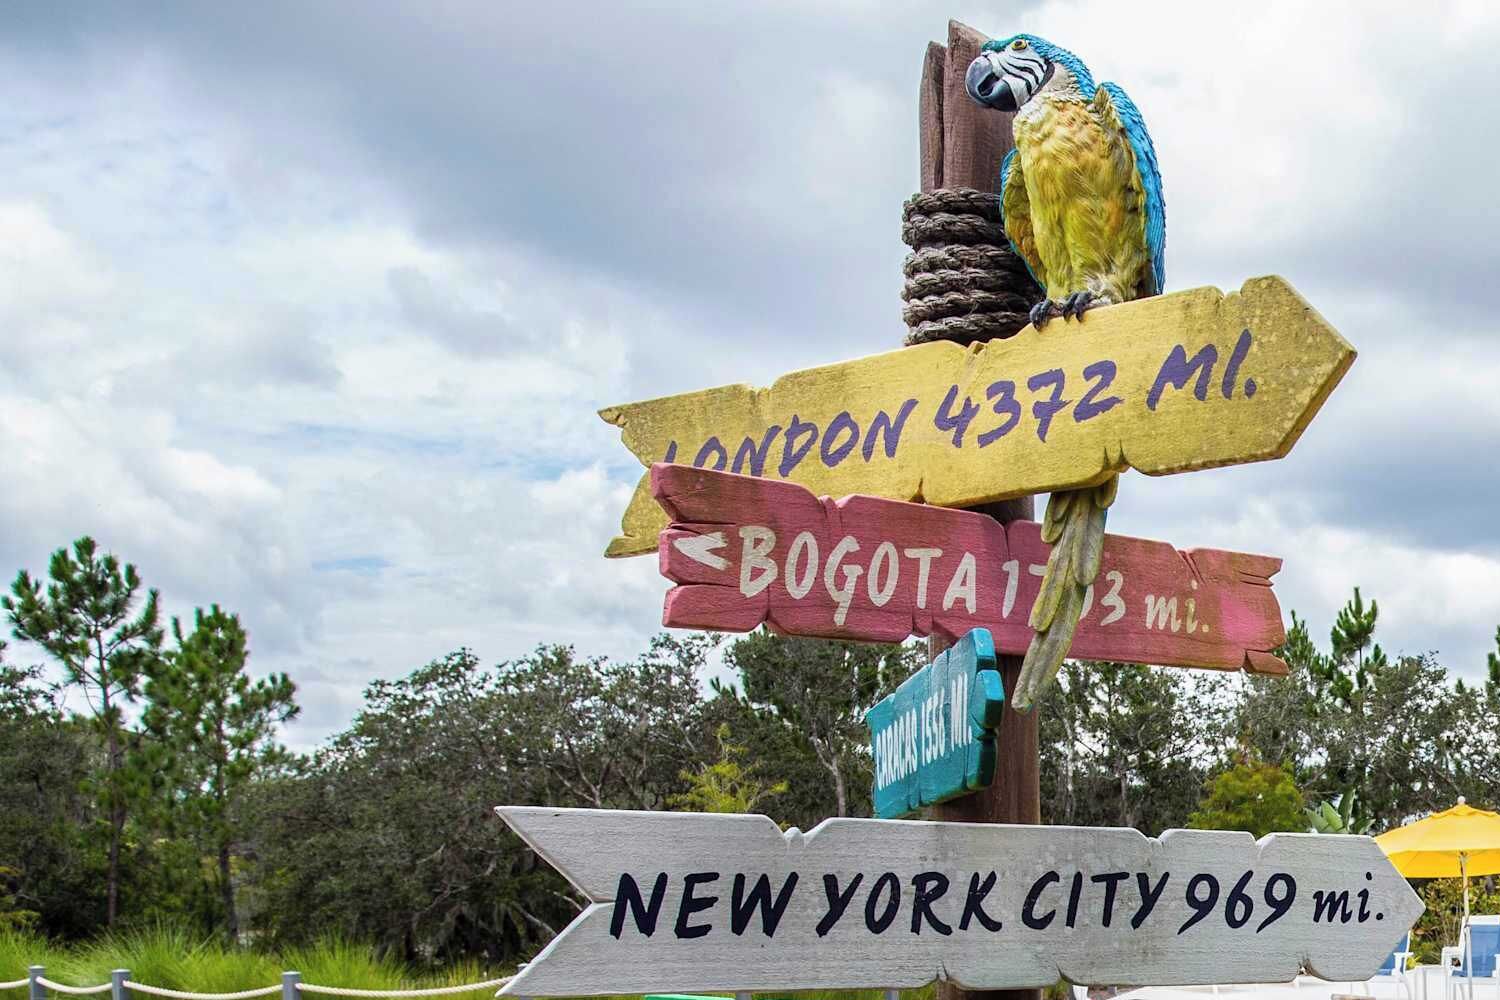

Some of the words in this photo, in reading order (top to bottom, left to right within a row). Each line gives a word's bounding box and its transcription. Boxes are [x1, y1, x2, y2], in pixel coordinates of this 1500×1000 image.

[934, 360, 1125, 448] 4372
[1146, 328, 1258, 411] MI.
[739, 525, 977, 626] BOGOTA
[1144, 579, 1210, 633] mi.
[876, 707, 918, 791] CARACAS
[951, 671, 972, 752] MI.
[609, 871, 800, 939] NEW
[815, 871, 1003, 938] YORK
[1021, 870, 1170, 930] CITY
[1177, 869, 1297, 935] 969
[1312, 871, 1384, 923] mi.
